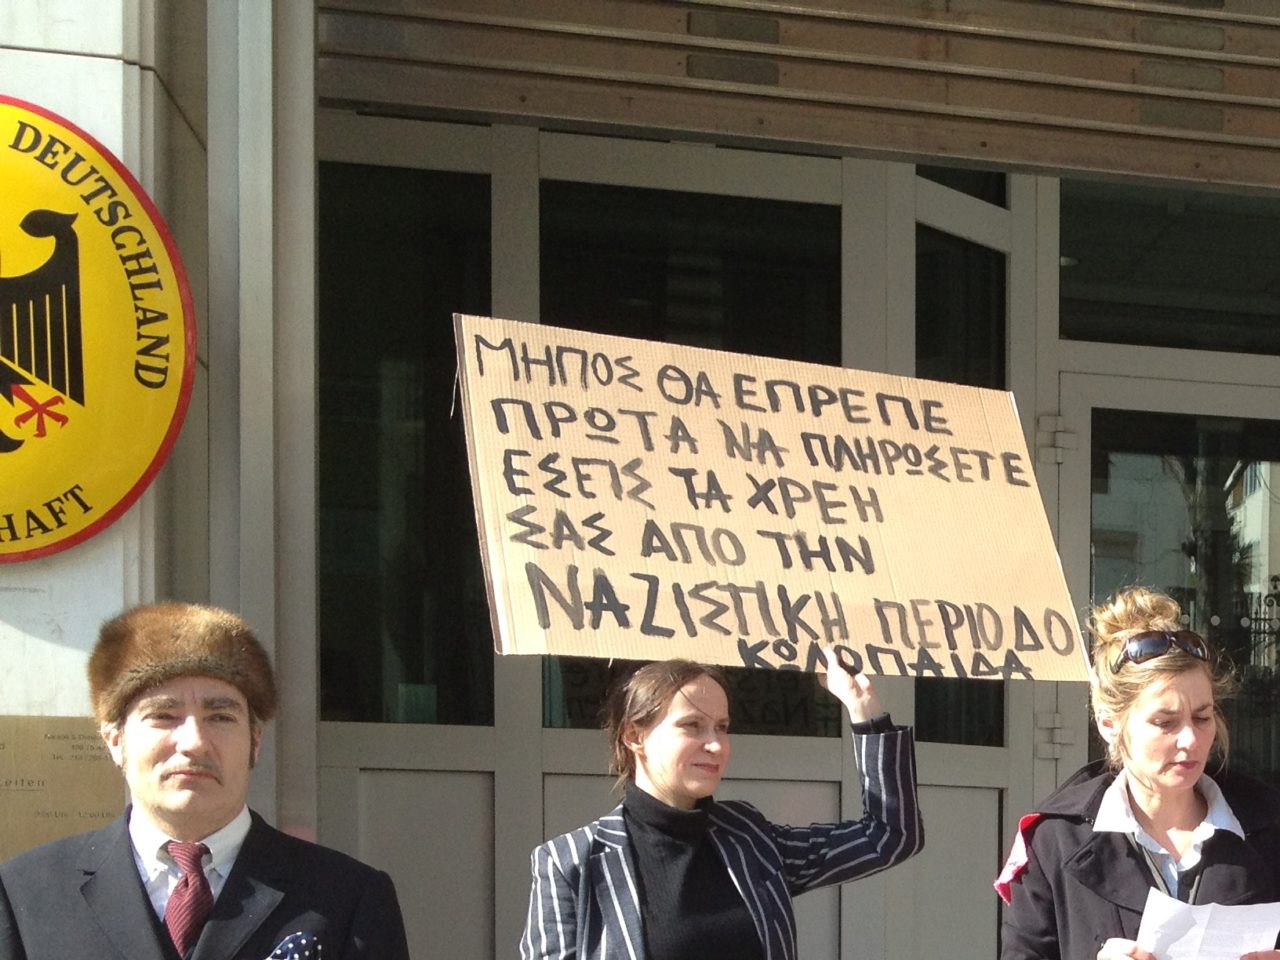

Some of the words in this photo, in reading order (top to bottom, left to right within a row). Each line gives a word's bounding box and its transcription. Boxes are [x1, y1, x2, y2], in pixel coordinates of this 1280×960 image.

[8, 120, 169, 390] DEUTSCHLAND
[474, 334, 643, 392] ΜΗΠΟΣ
[658, 364, 721, 407] ΘΑ
[734, 373, 953, 436] ΕΠΡΕΠΕ
[718, 420, 789, 467] ΝΑ
[668, 466, 733, 513] ΤΑ
[747, 473, 884, 524] ΧΡΕΗ
[506, 504, 617, 557] ΣΑΣ
[641, 519, 747, 567] ΑΠΟ
[757, 528, 876, 575] ΤΗΝ
[873, 598, 1075, 657] ΠΕΡΙΟΔΟ
